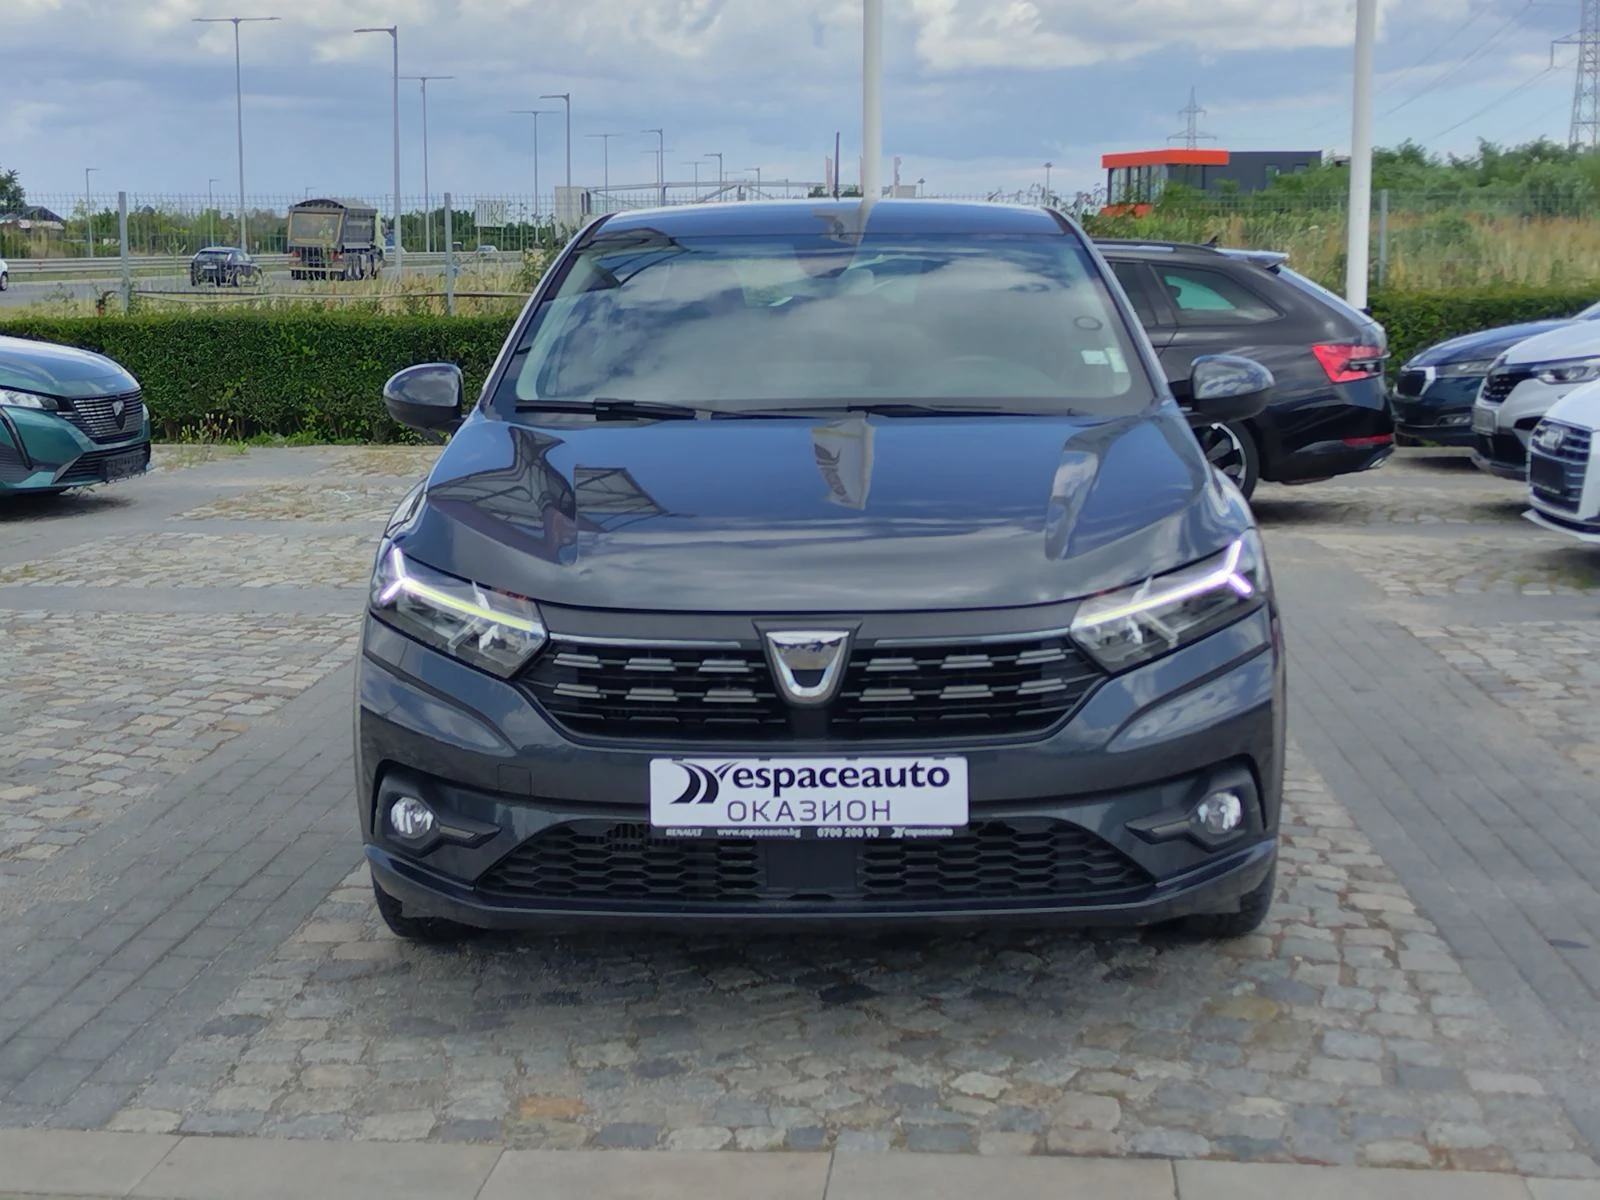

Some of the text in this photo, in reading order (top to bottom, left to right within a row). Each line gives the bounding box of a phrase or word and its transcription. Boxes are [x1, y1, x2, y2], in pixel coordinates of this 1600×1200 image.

[732, 761, 950, 797] espaceauto
[727, 800, 891, 822] ОКАЗИОН
[665, 828, 702, 836] RENAULT
[717, 827, 801, 838] www.espaceauto.bg
[817, 827, 843, 838] 0700
[844, 827, 864, 838] 200
